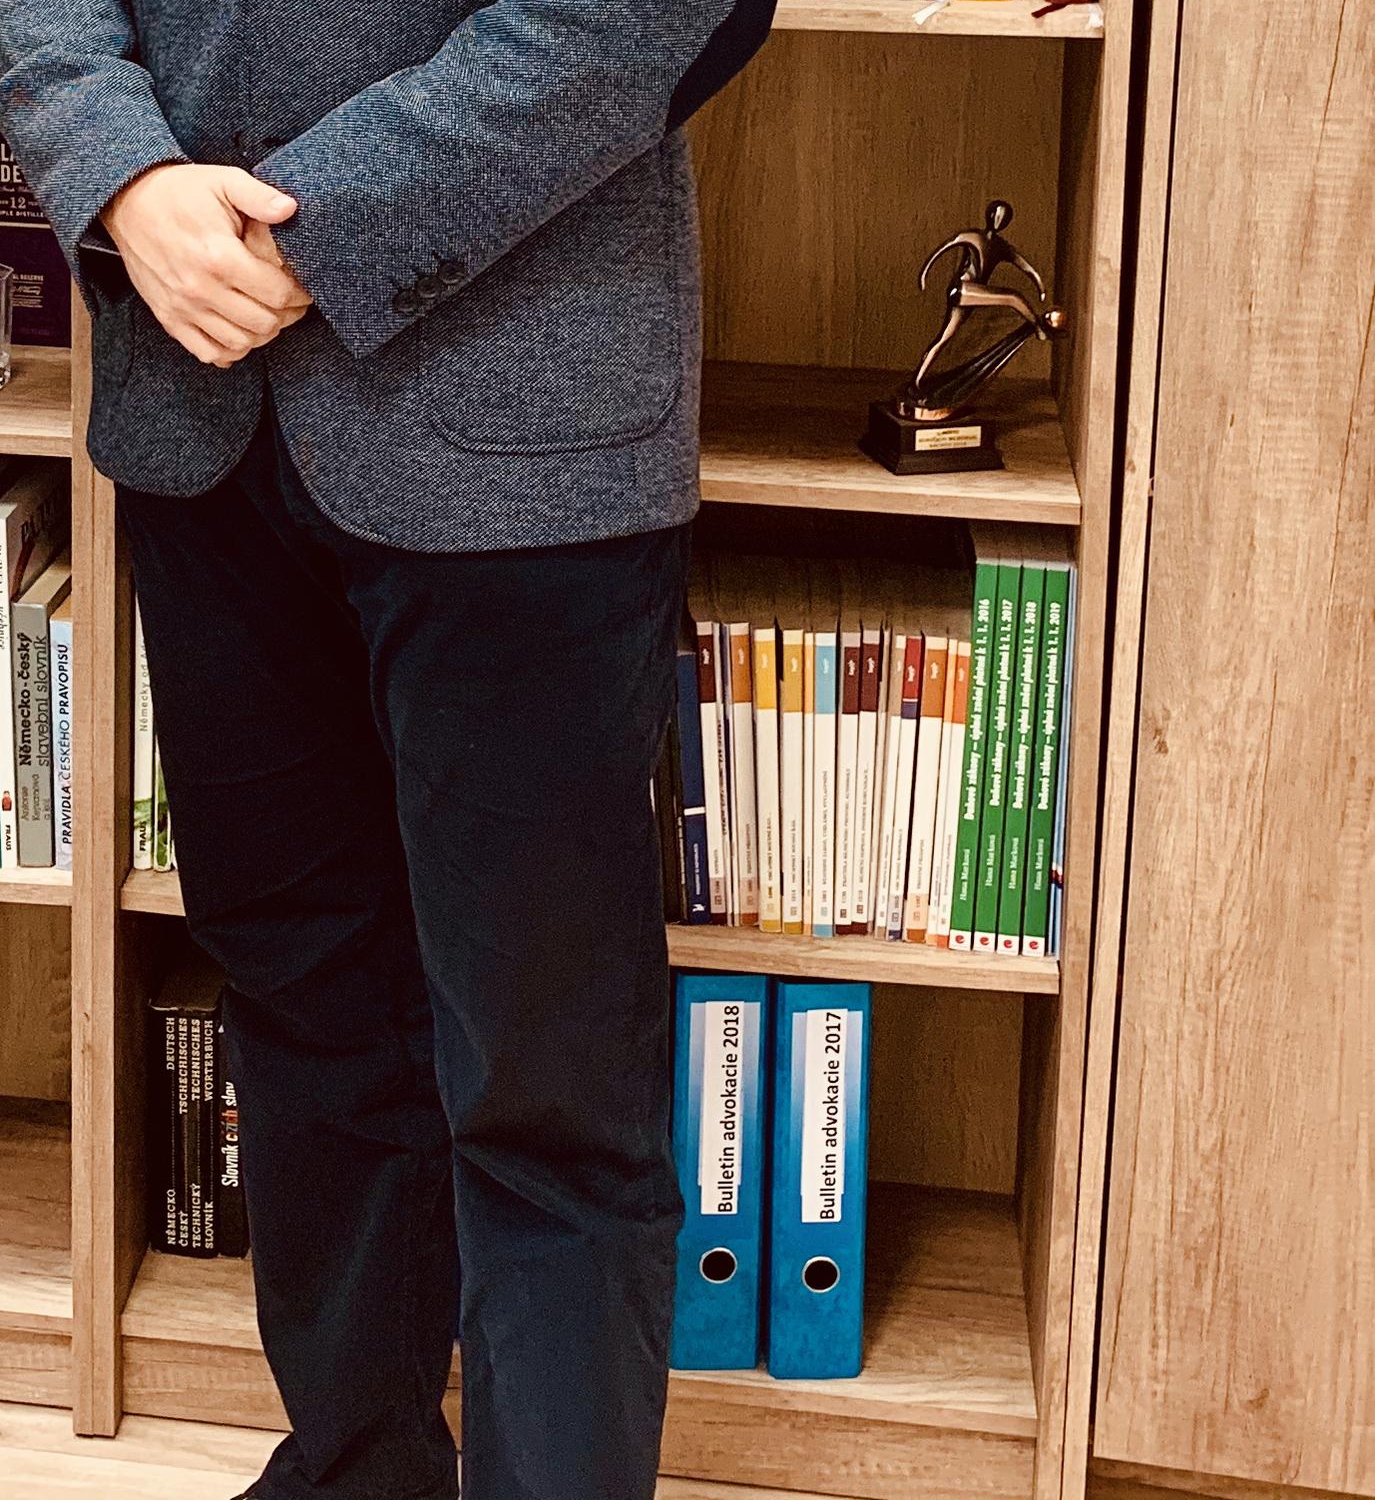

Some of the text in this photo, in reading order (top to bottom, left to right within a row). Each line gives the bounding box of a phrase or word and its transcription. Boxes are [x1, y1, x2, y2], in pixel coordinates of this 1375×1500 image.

[1, 165, 23, 183] DE
[10, 197, 26, 209] 12
[977, 598, 990, 622] 2016
[1002, 598, 1013, 622] 2017
[1025, 601, 1037, 624] 2018
[1049, 602, 1061, 625] 2019
[976, 636, 987, 644] 1.
[1001, 624, 1011, 632] 1.
[1023, 636, 1034, 644] 1.
[1024, 626, 1035, 634] 1.
[1048, 637, 1058, 645] 1.
[33, 636, 48, 693] slovník
[973, 655, 986, 686] platná
[997, 651, 1010, 681] platná
[1021, 653, 1033, 683] platná
[1045, 654, 1058, 684] platná
[139, 663, 150, 732] Německy od
[969, 714, 983, 740] úplná
[994, 706, 1007, 731] úplná
[1017, 708, 1031, 734] úplná
[1042, 709, 1056, 735] úplná
[58, 644, 72, 845] PRAVIDLA ČESKÉHO PRAVOPISU
[992, 741, 1006, 773] zákony
[1015, 743, 1029, 775] zákony
[1039, 744, 1054, 776] zákony
[966, 752, 981, 785] zákony
[964, 786, 977, 820] Daňové
[989, 774, 1001, 806] Daňové
[1012, 776, 1025, 809] Daňové
[1037, 777, 1049, 810] Daňové
[139, 820, 147, 851] FRAUS
[221, 1081, 238, 1107] slov
[718, 1005, 740, 1213] Bulletin advokacie 2018
[166, 1017, 176, 1245] NĚMECKO DEUTSCH
[819, 1012, 842, 1221] Bulletin advokacie 2017
[178, 1018, 188, 1247] ČESKÝ TSCHECHISCHES
[191, 1018, 201, 1248] TECHNICKÝ TECHNISCHES
[221, 1143, 239, 1188] Slovník
[204, 1200, 214, 1249] SLOVNÍK
